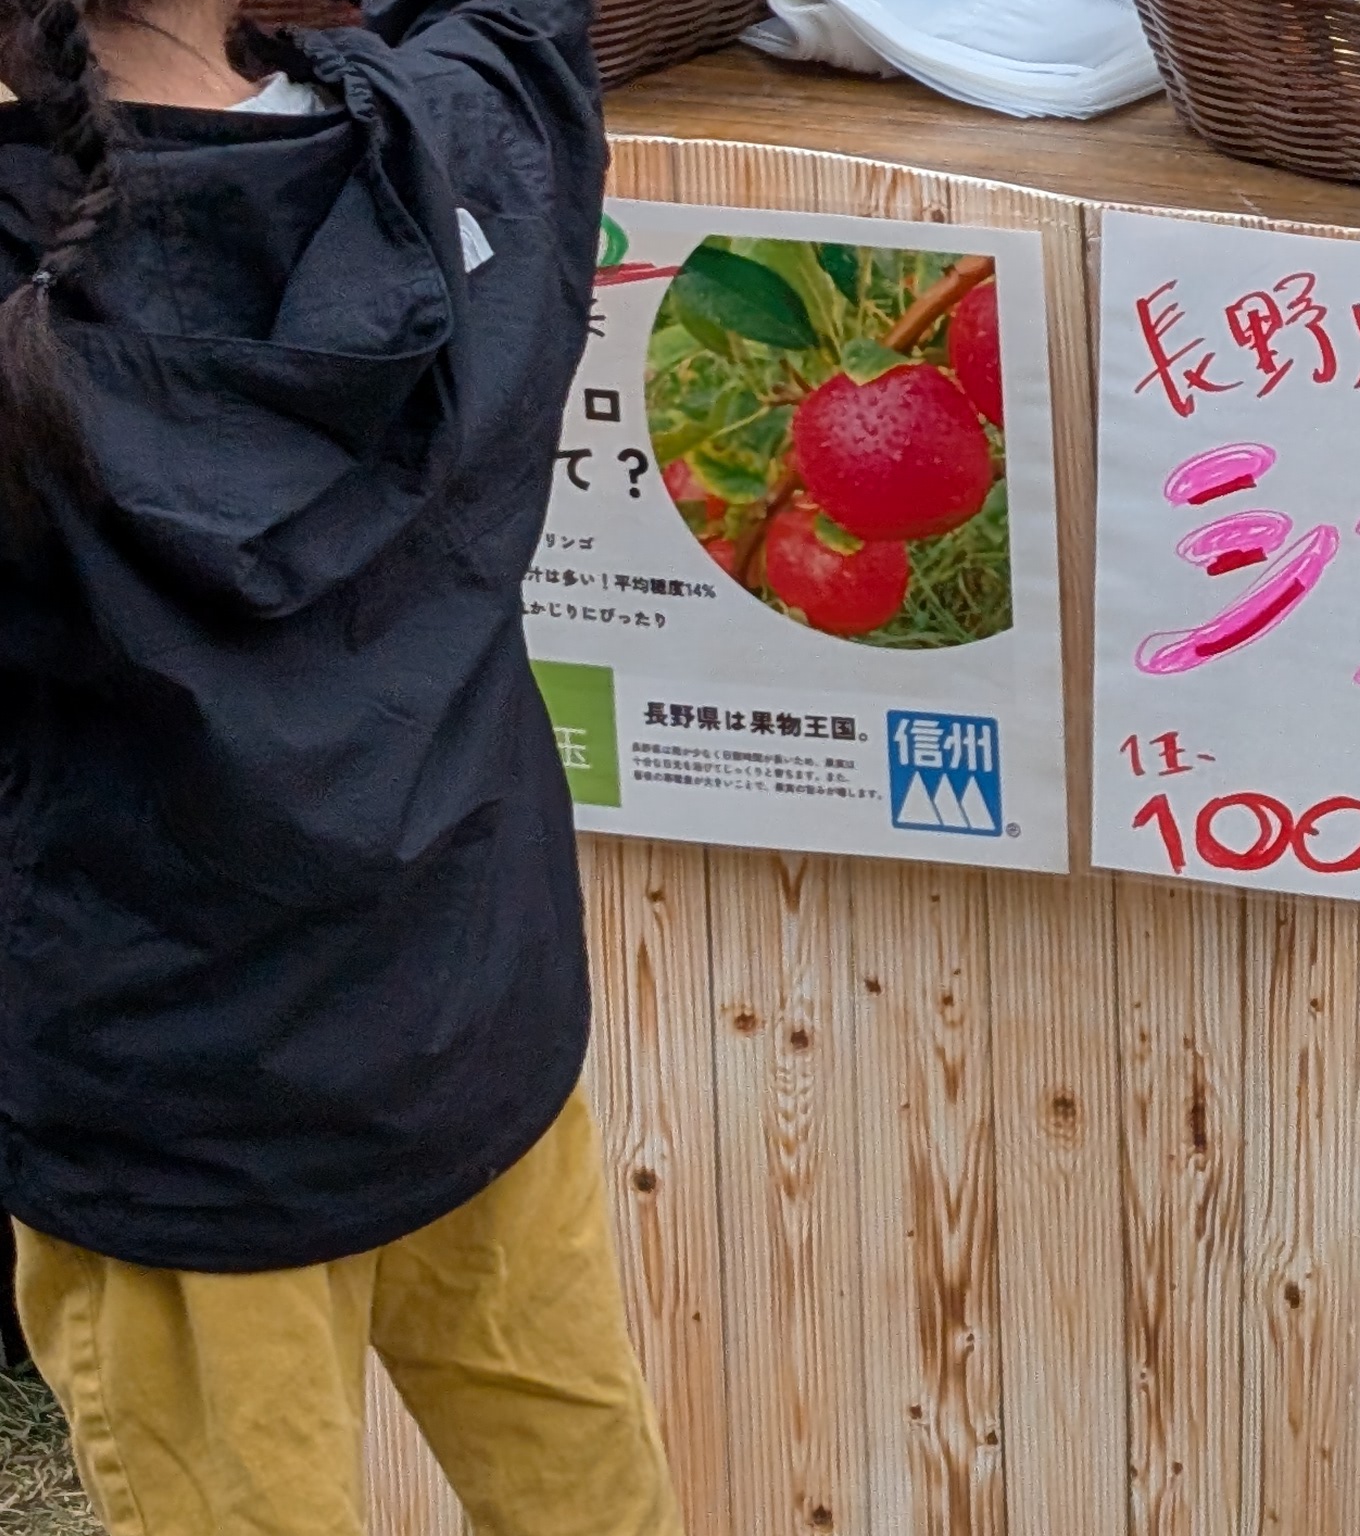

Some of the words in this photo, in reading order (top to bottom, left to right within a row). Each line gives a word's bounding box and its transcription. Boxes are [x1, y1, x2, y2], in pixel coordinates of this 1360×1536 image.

[643, 700, 870, 743] 長野県は果物王国。
[893, 717, 993, 773] 信州
